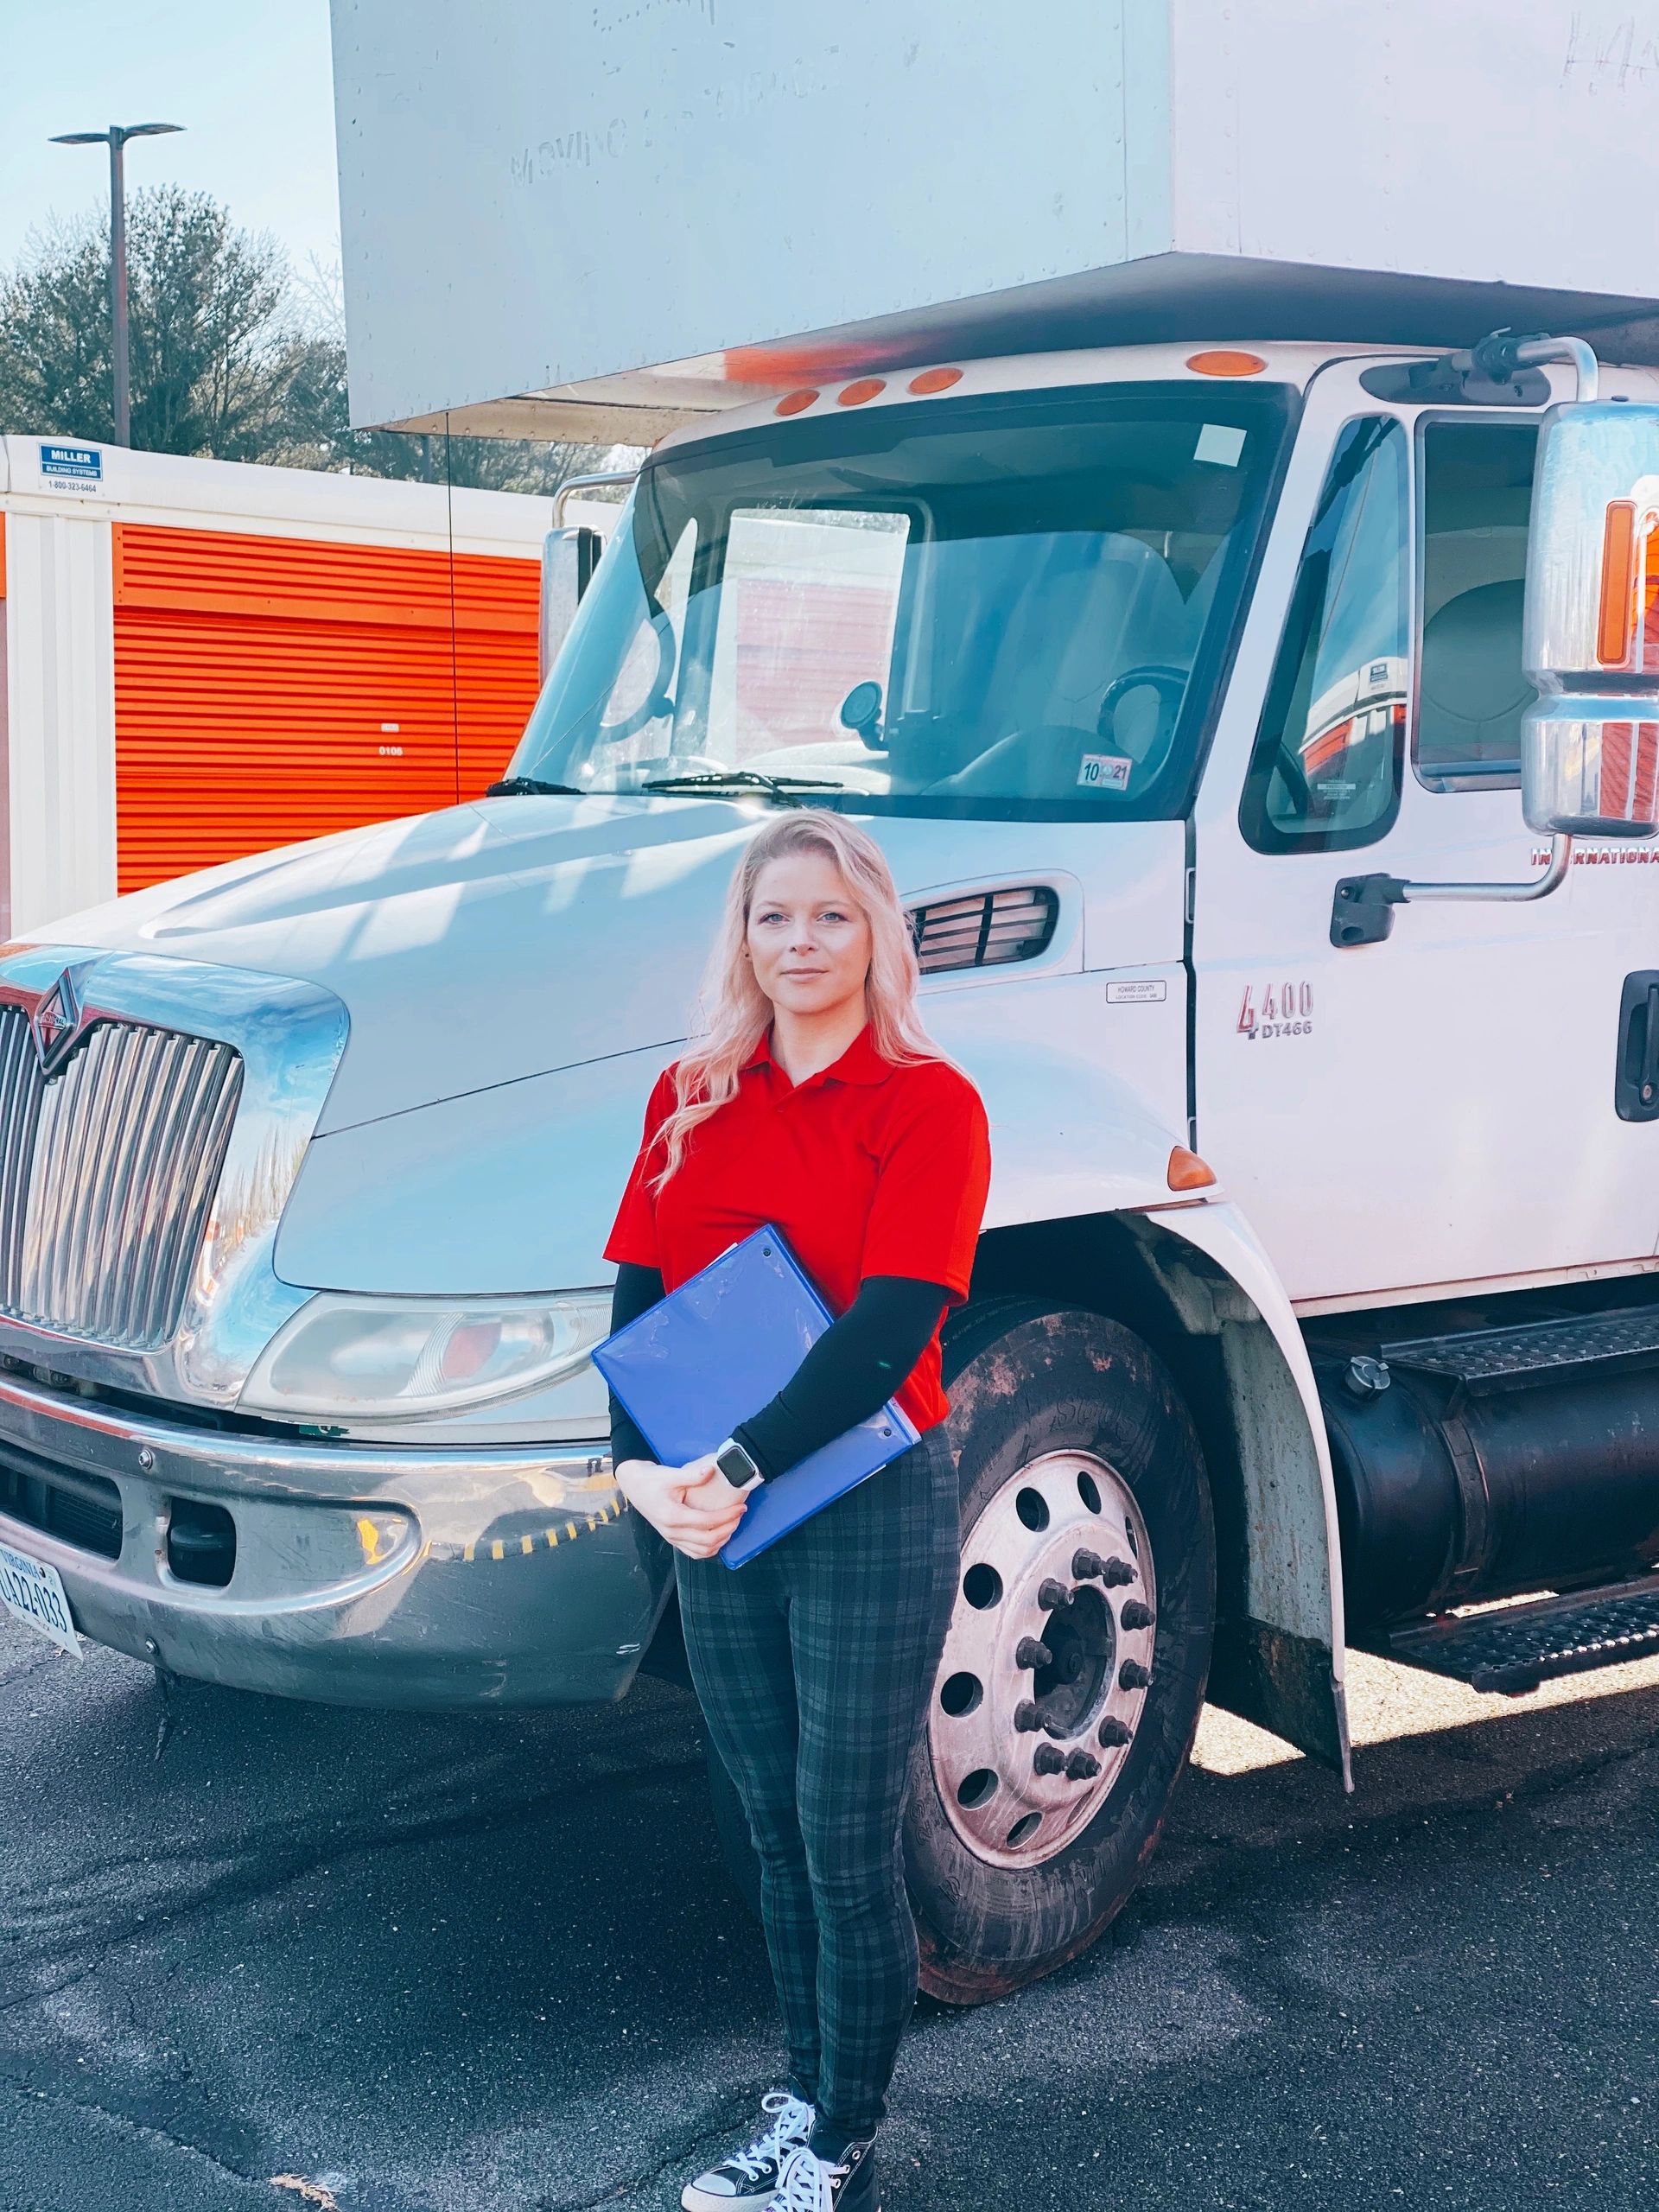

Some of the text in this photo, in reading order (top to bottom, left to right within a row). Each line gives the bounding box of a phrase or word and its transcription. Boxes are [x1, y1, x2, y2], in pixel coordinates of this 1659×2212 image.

[51, 449, 91, 464] MILLER
[46, 465, 98, 477] BUILDING SYSTEMS
[48, 480, 97, 493] 1-800-323-6464
[1084, 762, 1128, 781] 10 21
[1531, 847, 1659, 866] INRNATIONA
[1237, 982, 1313, 1040] 4400
[1262, 1020, 1313, 1039] DT466
